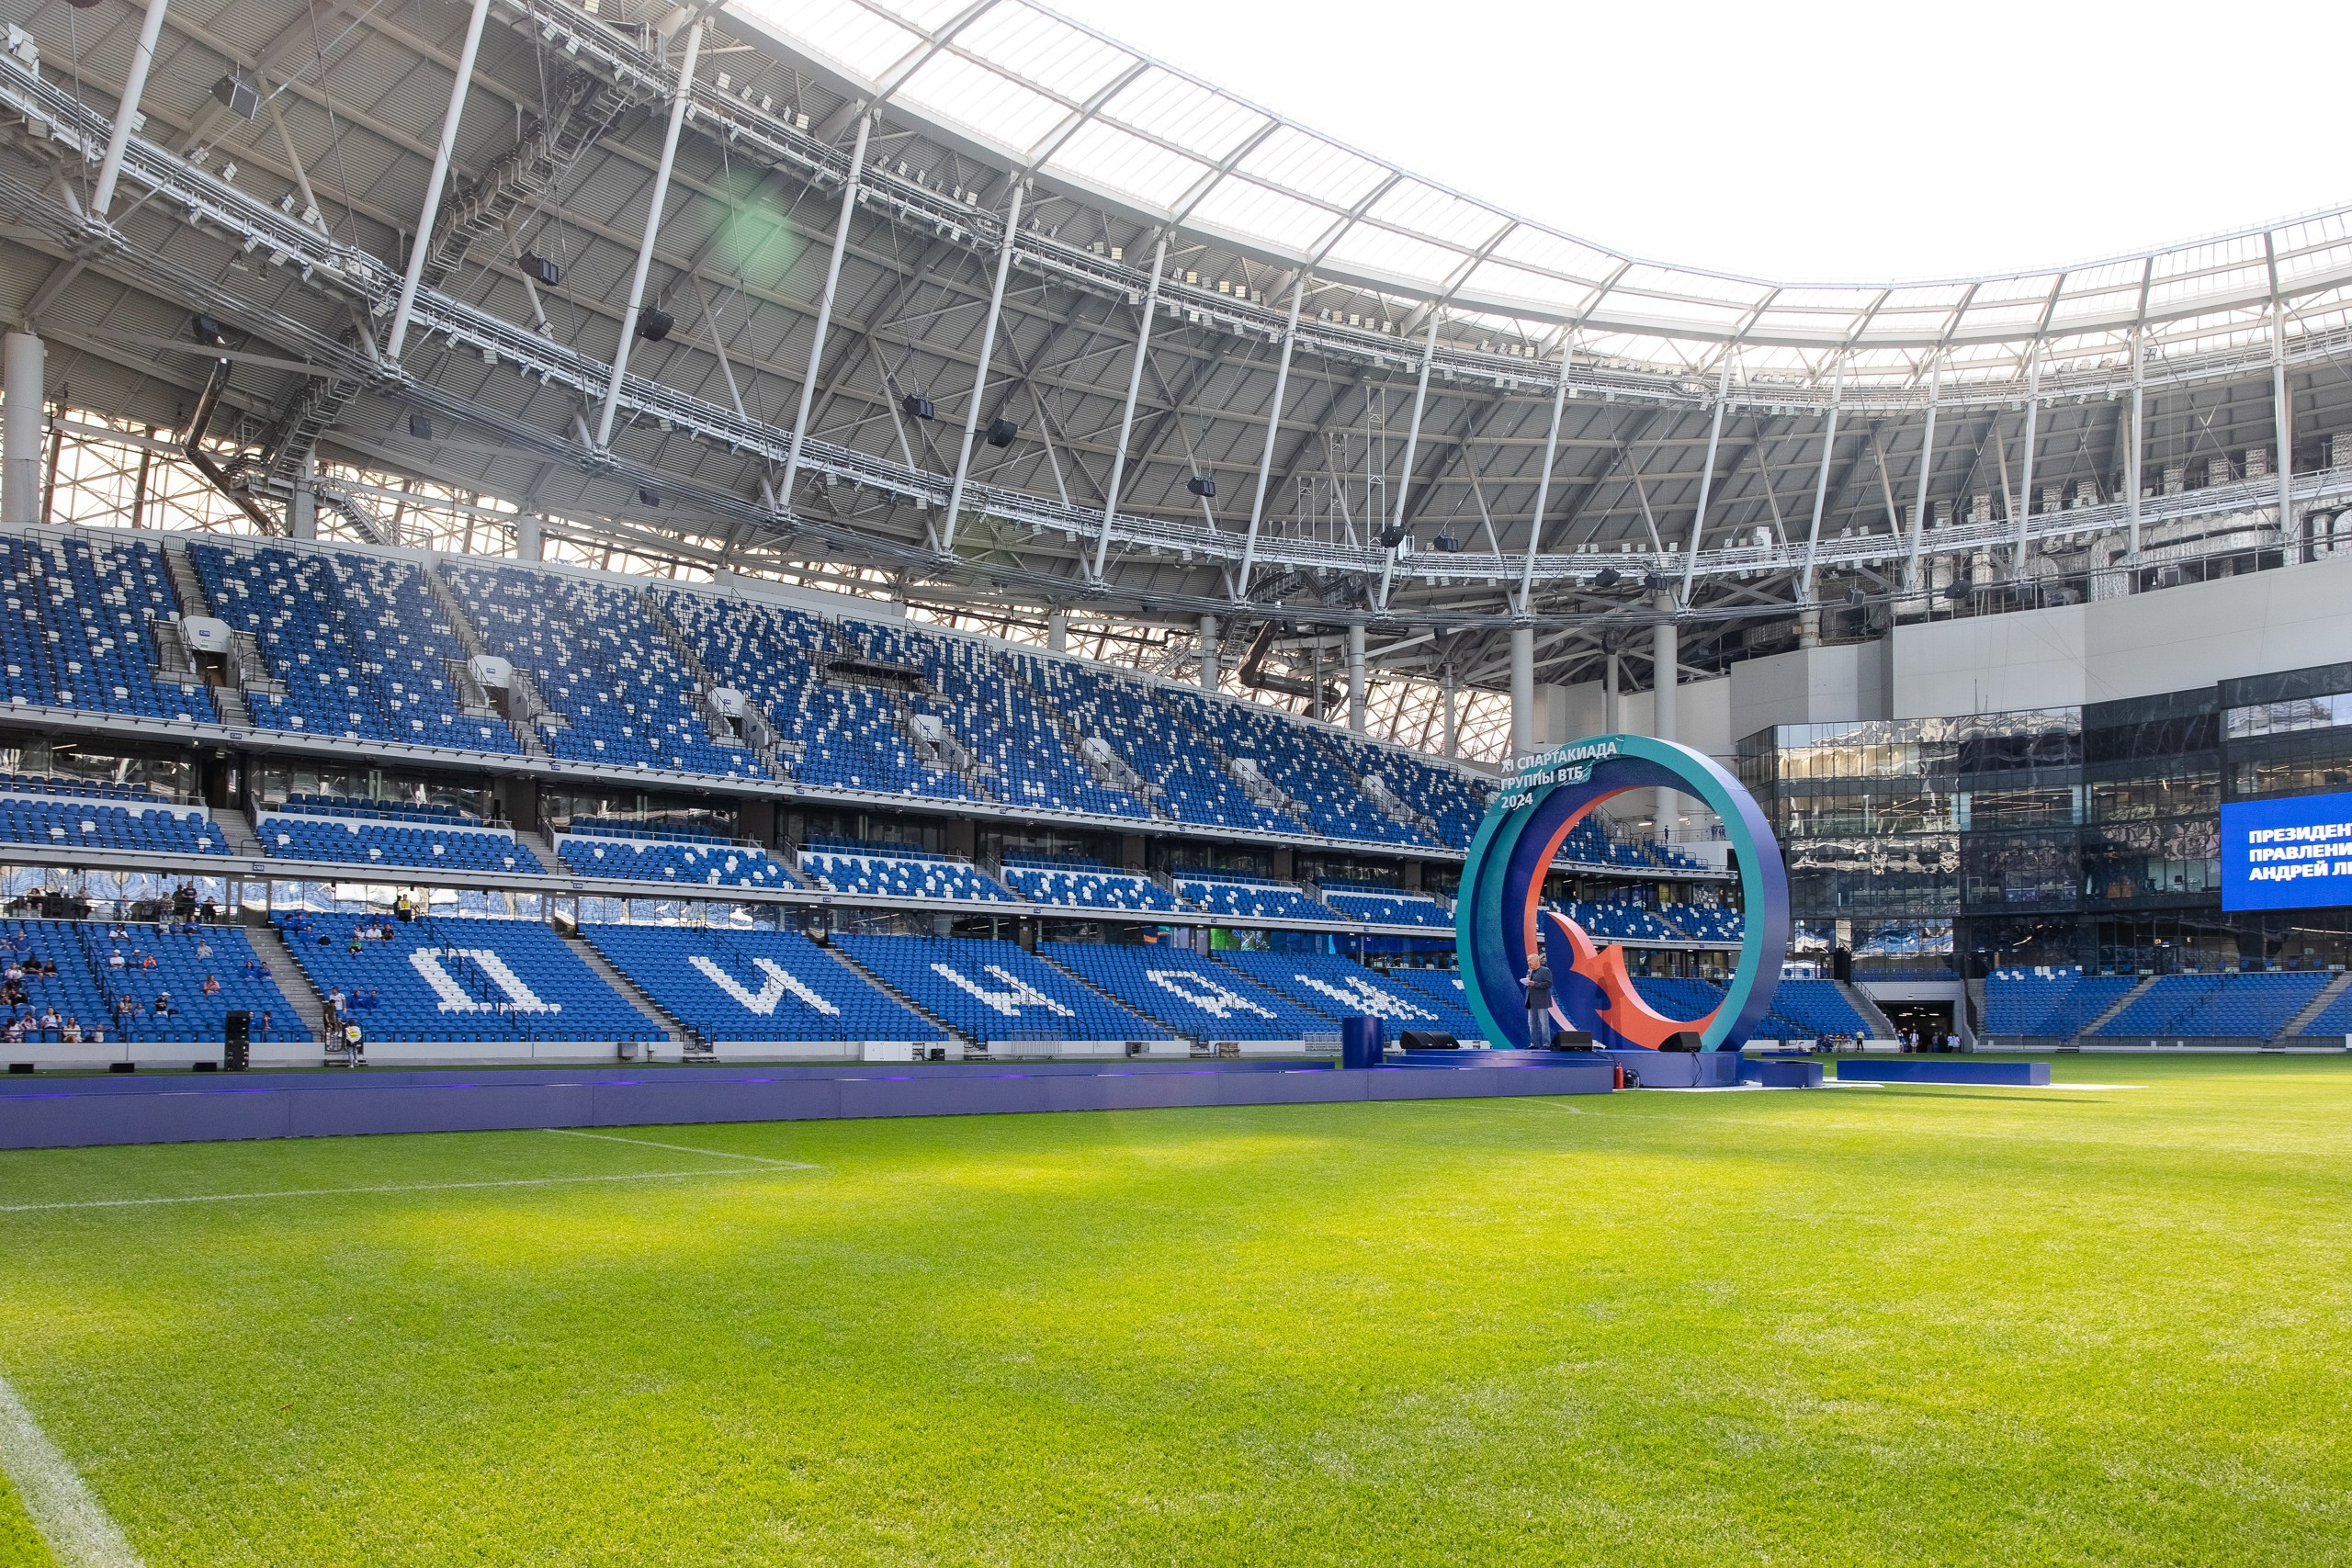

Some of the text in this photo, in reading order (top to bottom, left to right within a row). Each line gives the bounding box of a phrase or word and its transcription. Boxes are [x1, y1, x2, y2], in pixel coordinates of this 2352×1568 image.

[1516, 741, 1617, 769] СПАРТАКИАДА
[1500, 766, 1583, 791] ГРУППЫ ВТБ
[1501, 793, 1533, 809] 2024
[2248, 860, 2329, 882] АНДРЕЙ
